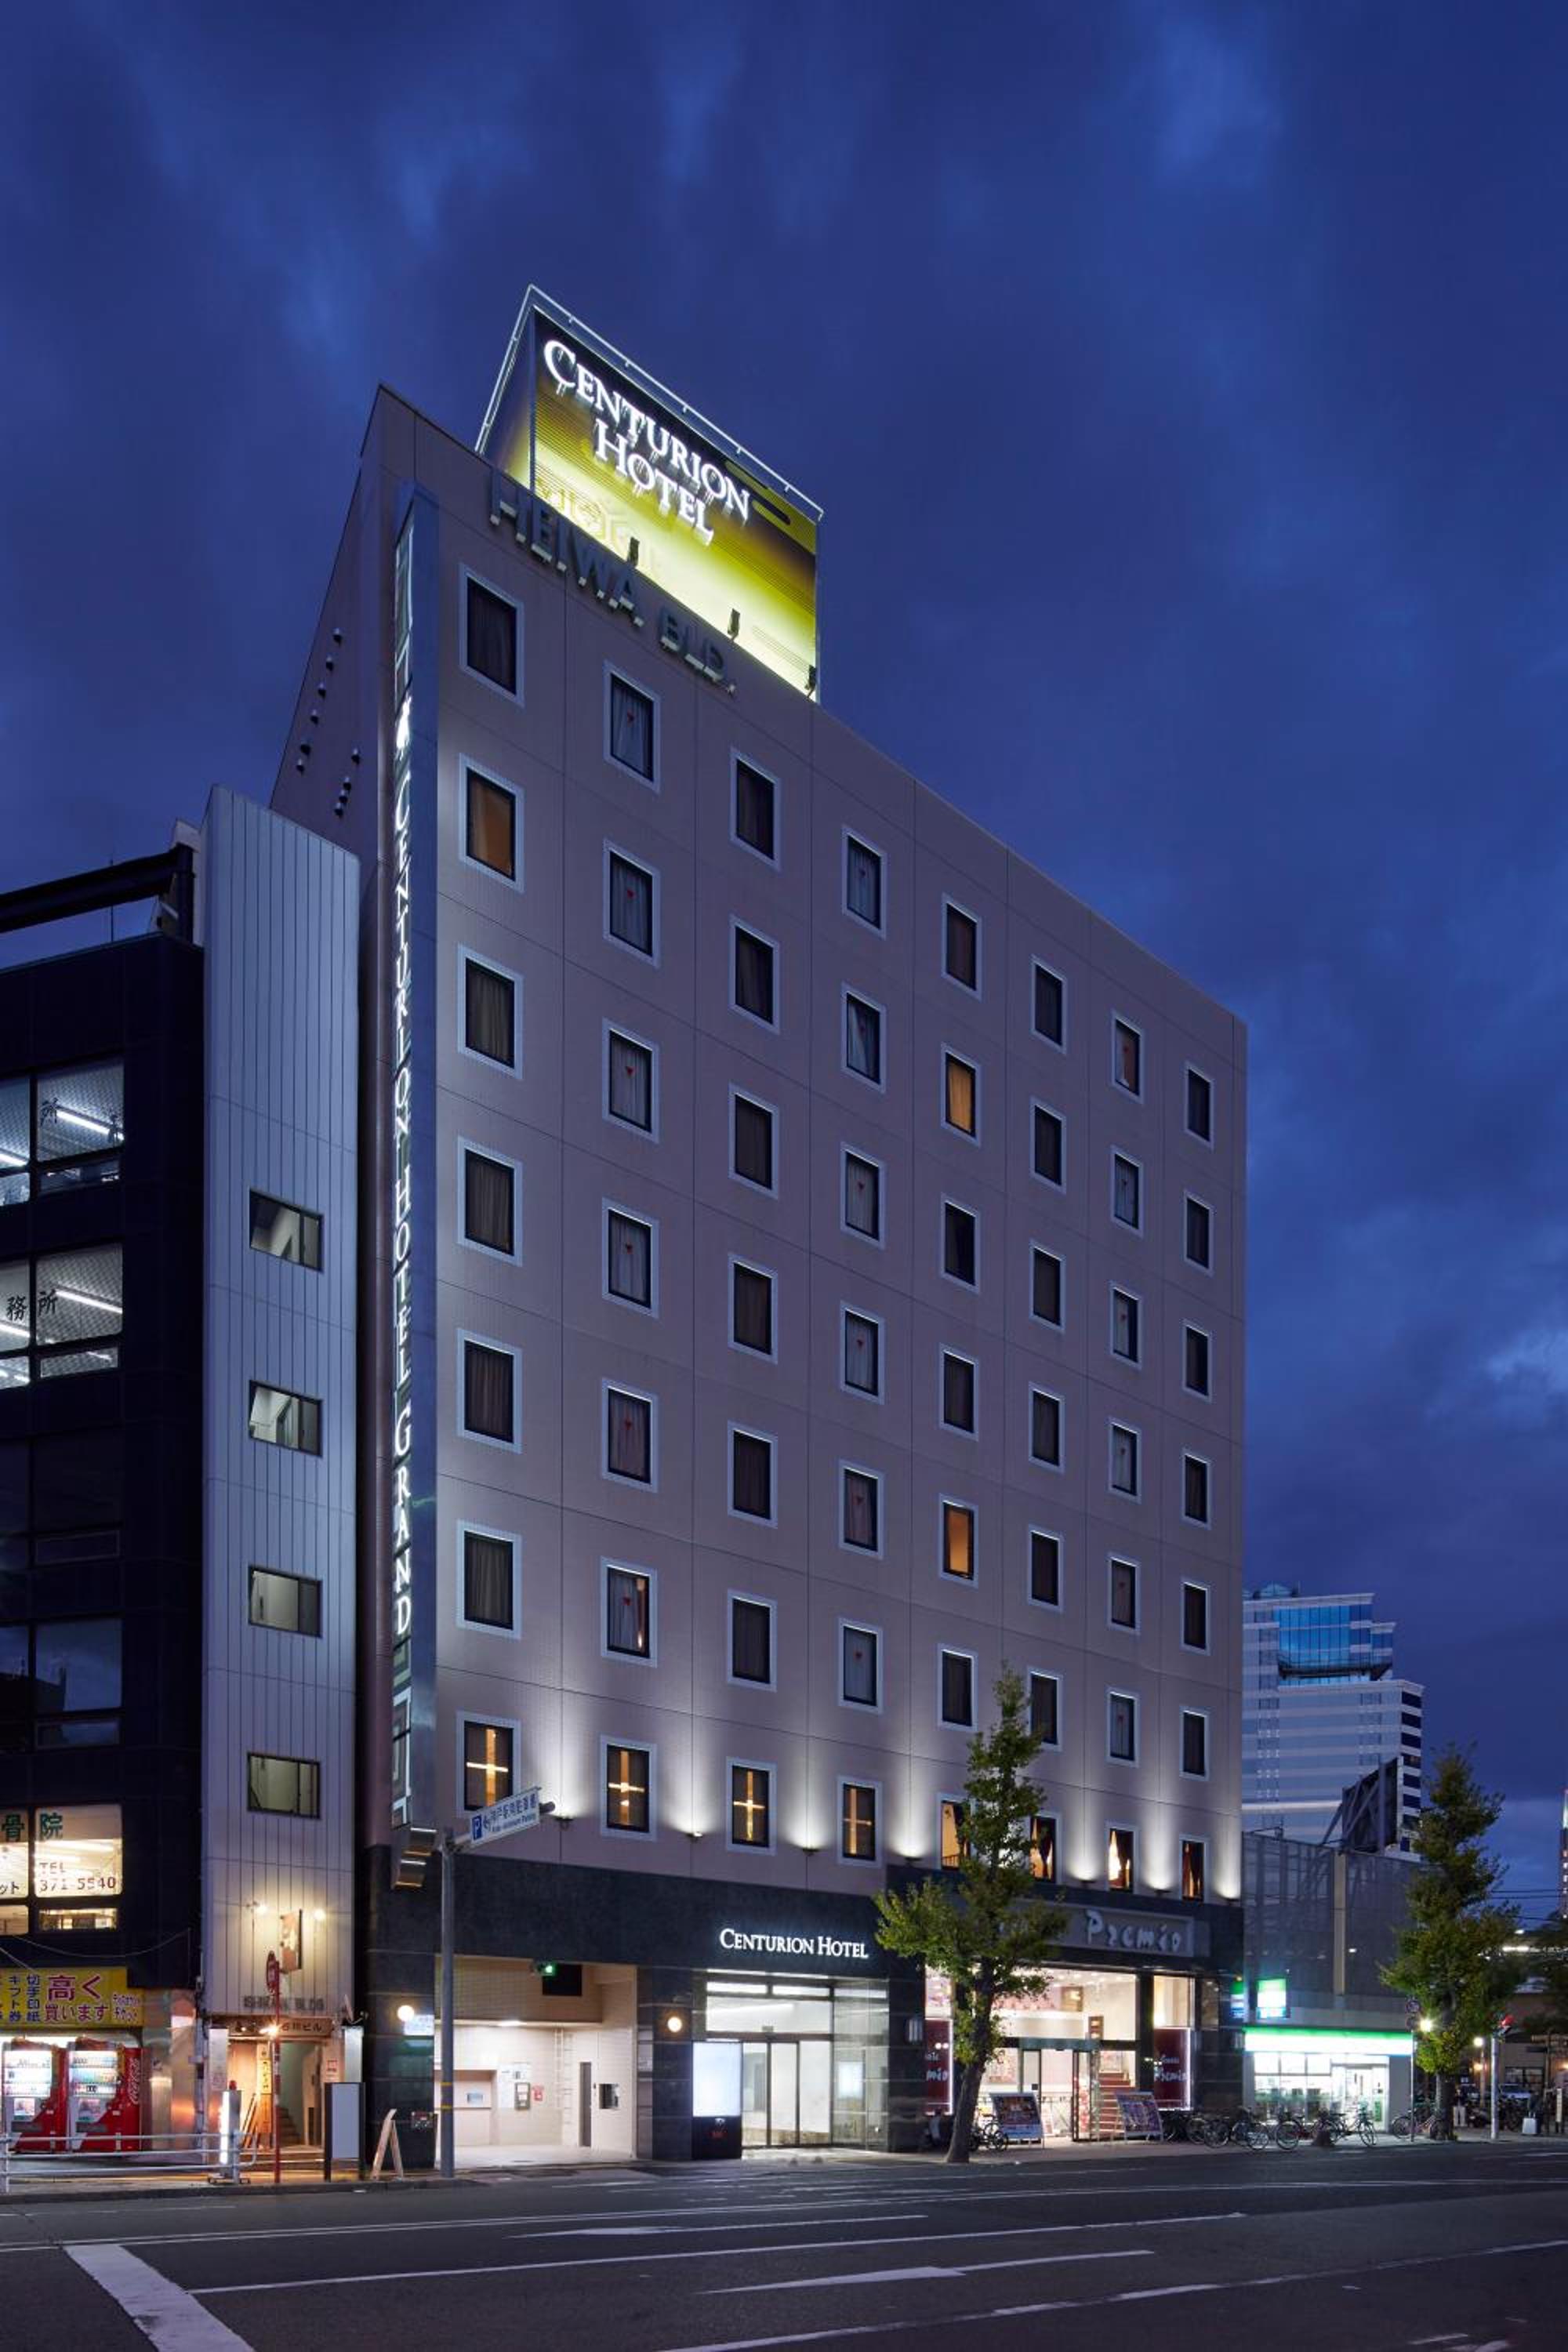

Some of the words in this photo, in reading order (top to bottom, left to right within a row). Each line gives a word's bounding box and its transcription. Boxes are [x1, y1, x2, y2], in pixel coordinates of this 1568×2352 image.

[543, 339, 750, 521] CENTURION
[594, 418, 714, 539] HOTEL
[488, 468, 644, 627] HEIWA
[394, 1163, 412, 1388] HOTEL
[394, 1399, 412, 1635] GRAND
[39, 1862, 67, 1875] TEL
[47, 1974, 101, 2002] 高く
[719, 1927, 815, 1955] CENTURION
[817, 1935, 869, 1959] HOTEL
[45, 2002, 109, 2022] 買います
